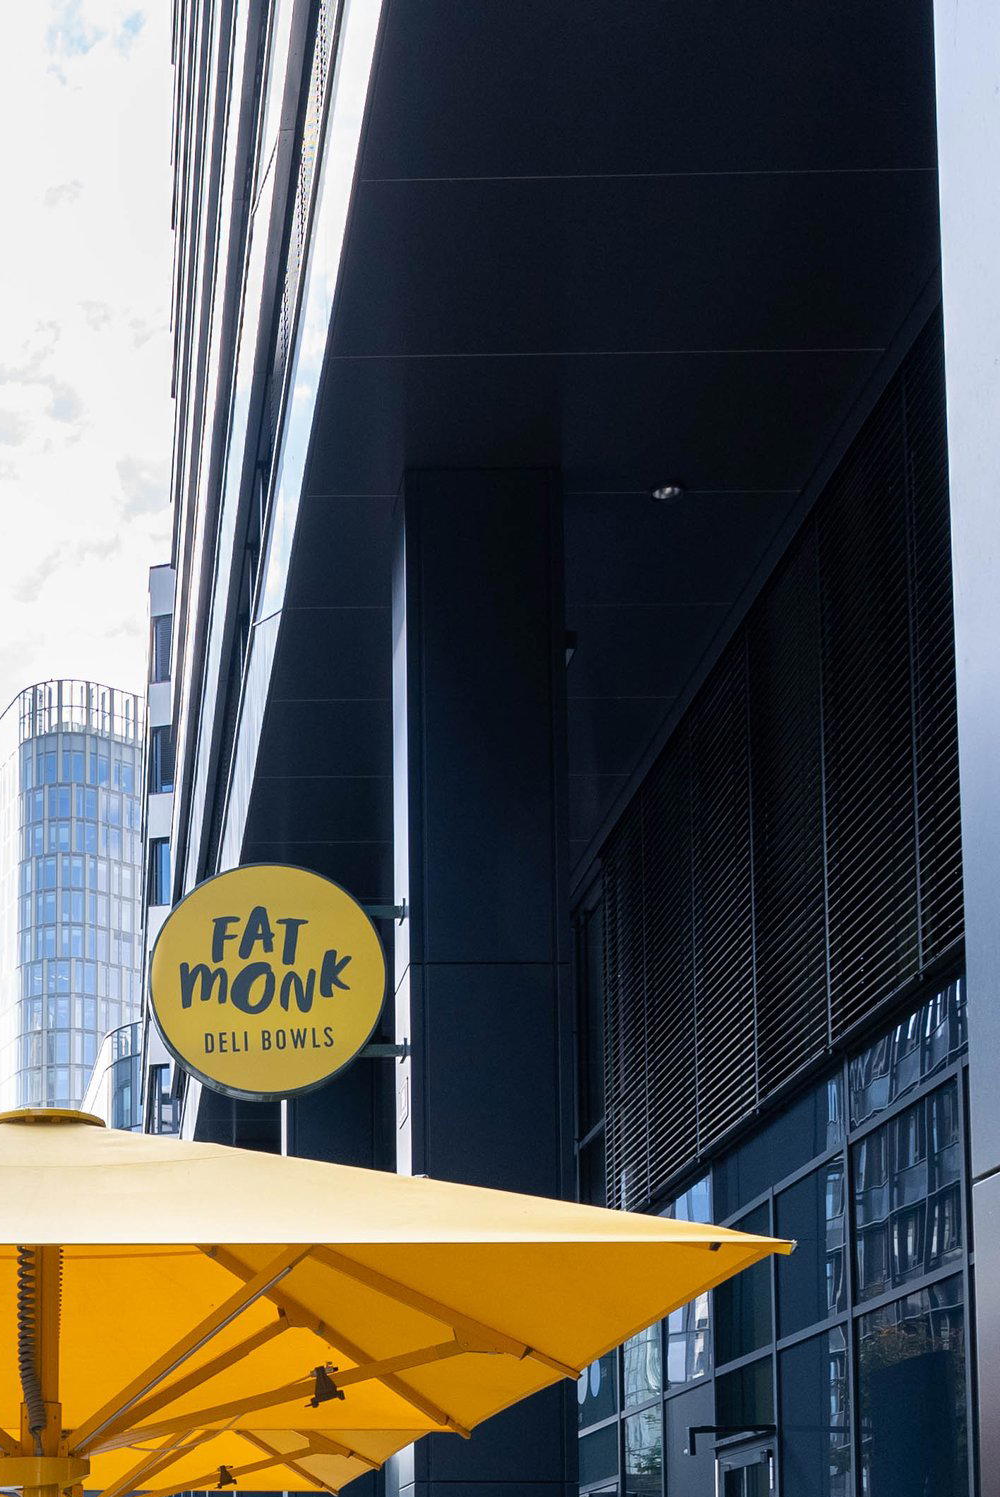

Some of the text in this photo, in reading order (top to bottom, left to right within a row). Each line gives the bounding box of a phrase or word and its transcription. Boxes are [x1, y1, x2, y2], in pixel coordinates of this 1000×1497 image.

[211, 905, 309, 966] FAT
[179, 949, 352, 1015] MONK
[204, 1026, 335, 1054] DELI BOWLS
